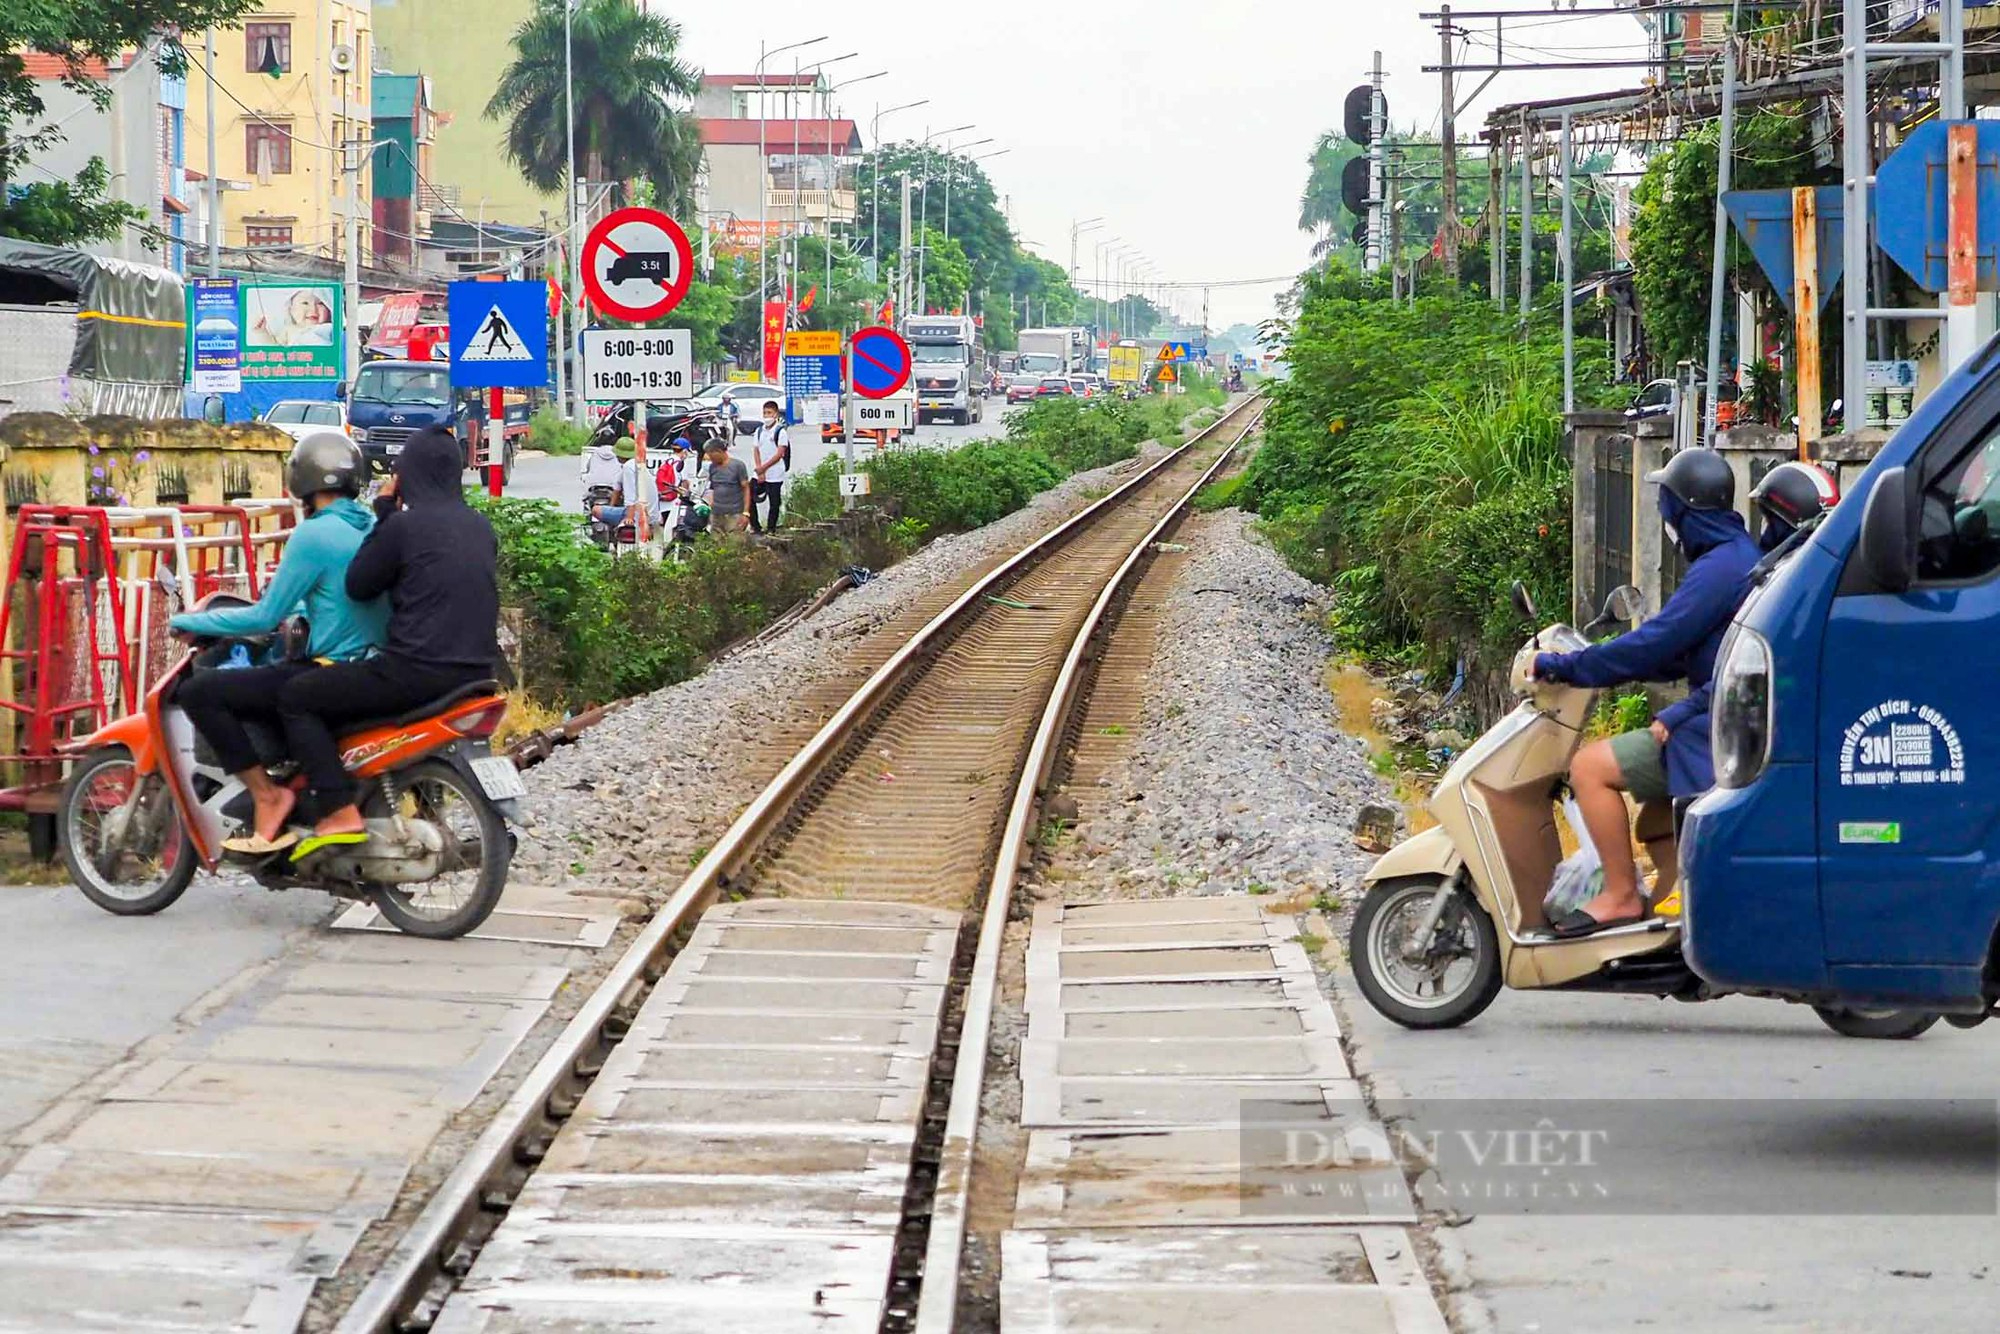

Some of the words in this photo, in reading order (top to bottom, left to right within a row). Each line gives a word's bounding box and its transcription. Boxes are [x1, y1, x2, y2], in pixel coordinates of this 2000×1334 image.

[640, 260, 660, 271] 3.5t
[604, 339, 674, 357] 6:00-9:00
[593, 371, 682, 389] 16:00-19:30
[860, 408, 881, 419] 600
[885, 410, 895, 419] m
[848, 483, 857, 493] 7
[1879, 699, 1910, 717] BÍCH
[1860, 736, 1892, 765] 3N
